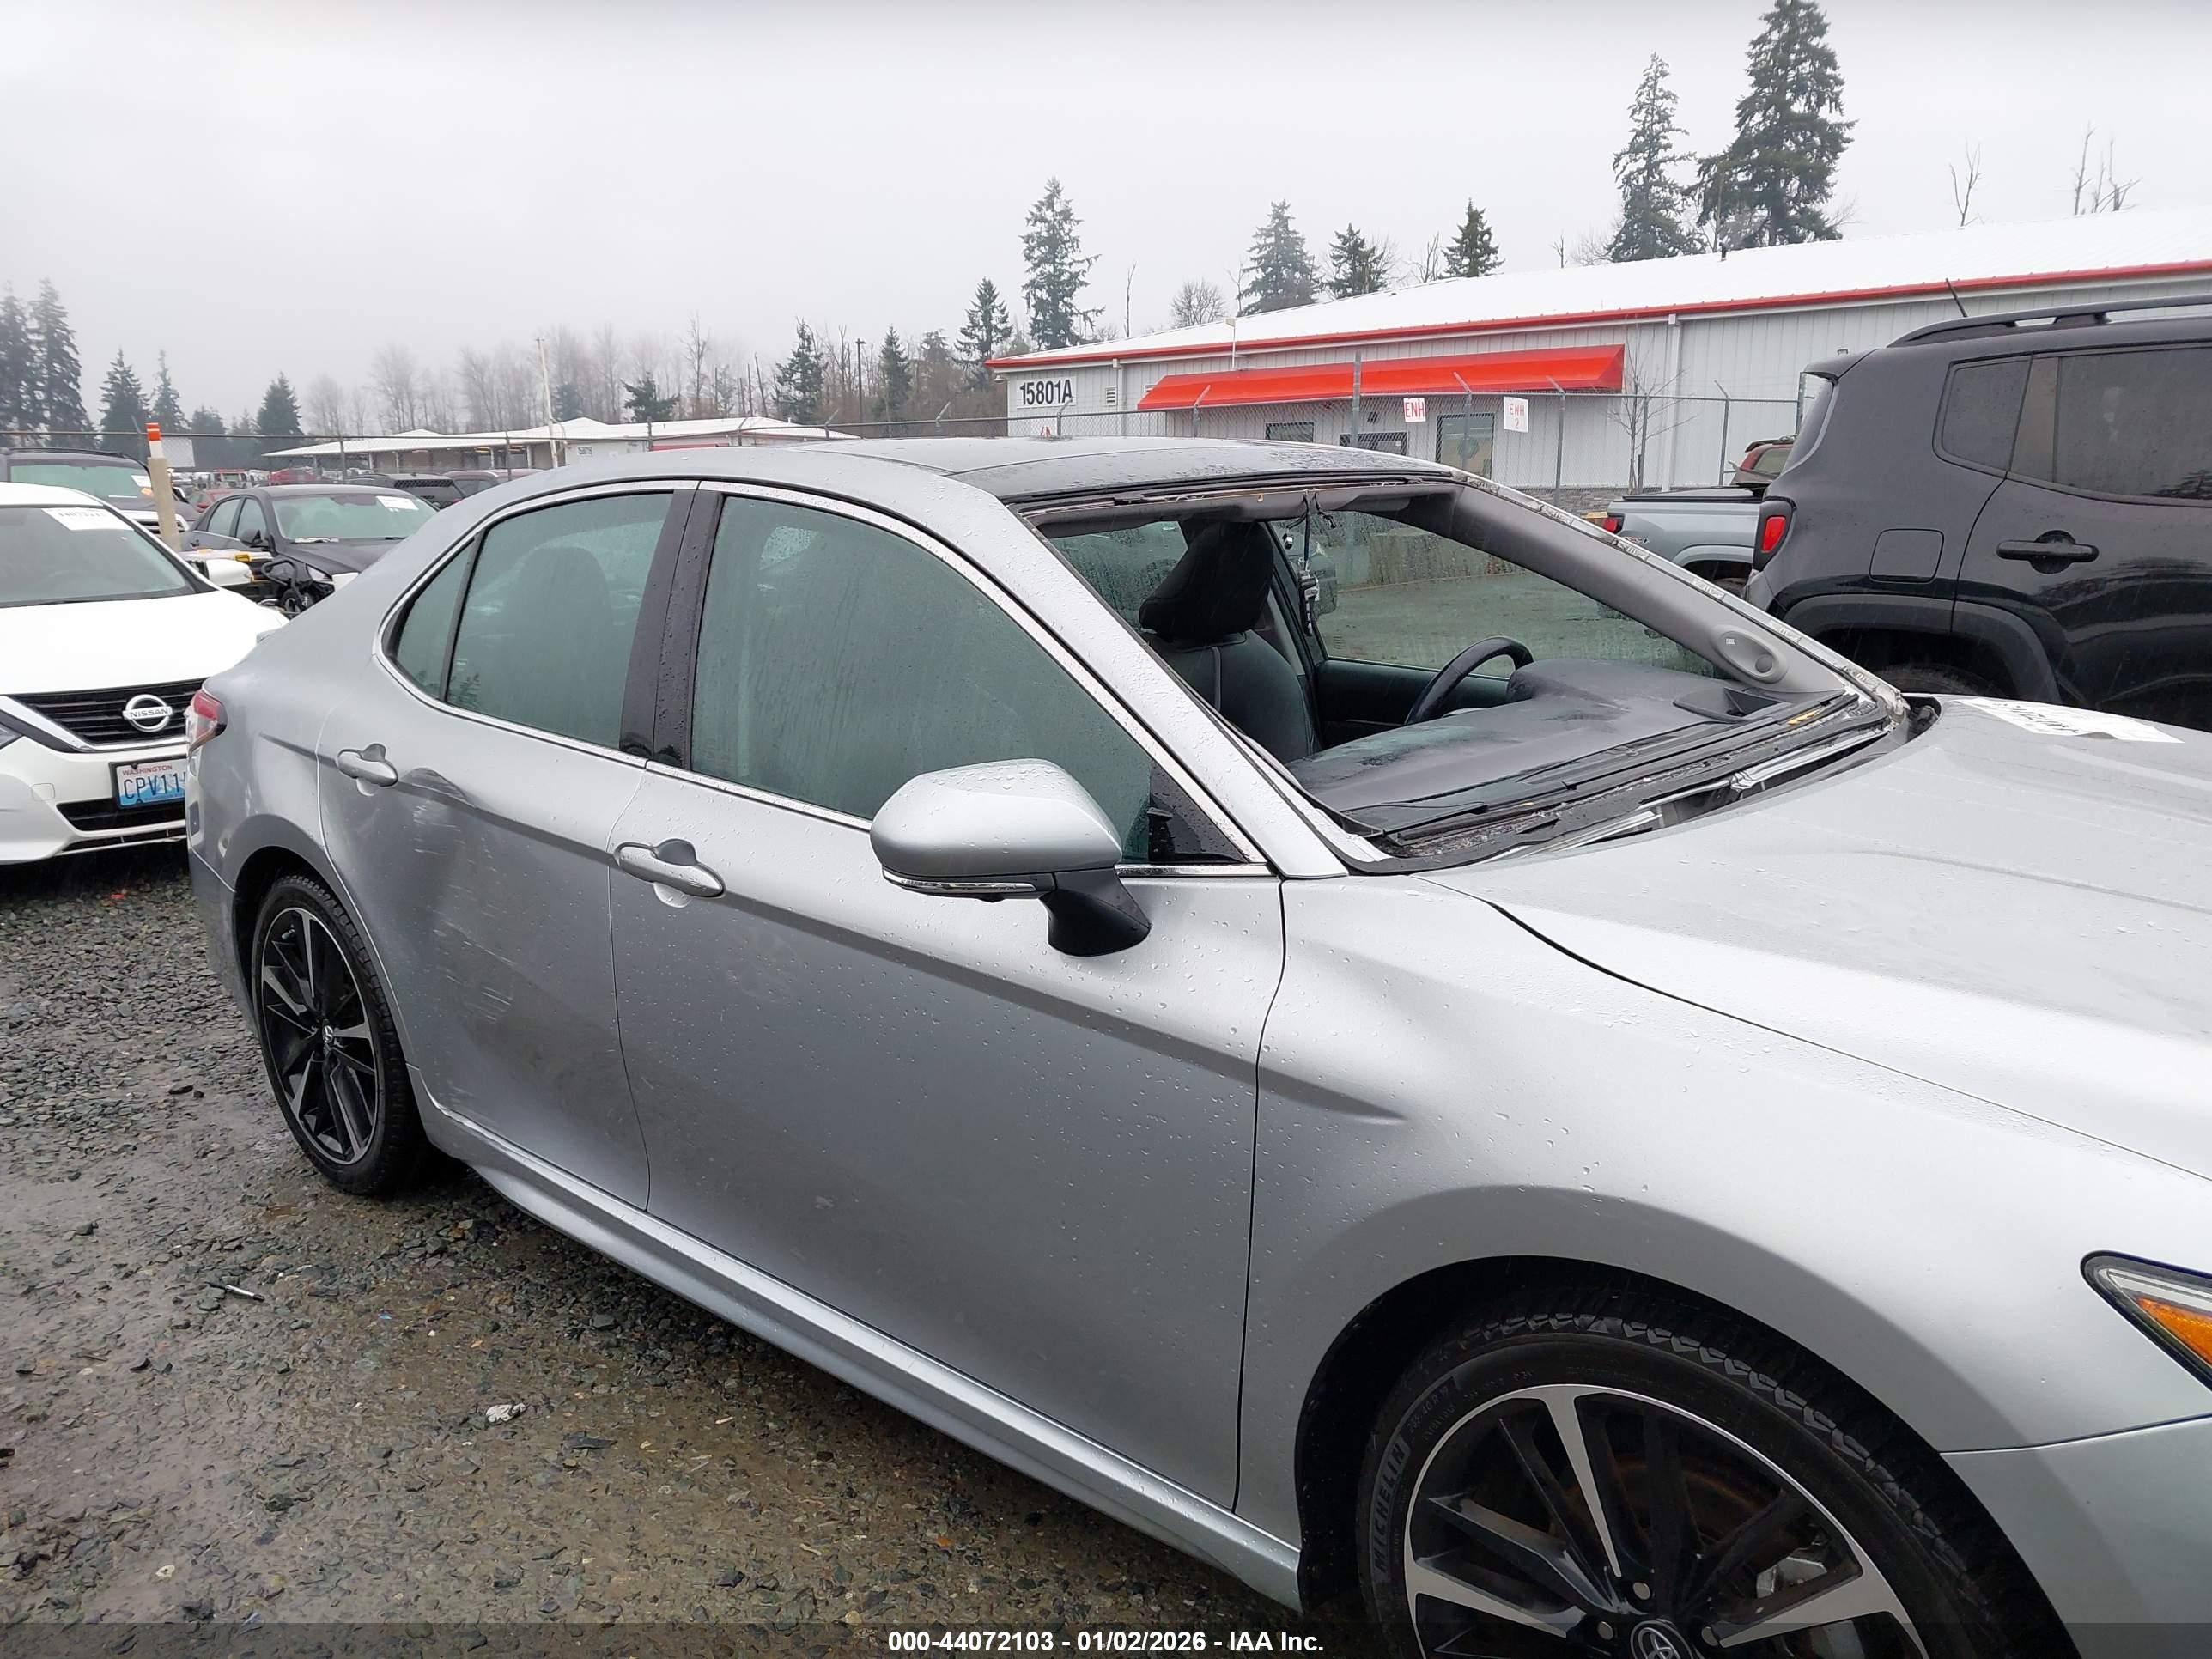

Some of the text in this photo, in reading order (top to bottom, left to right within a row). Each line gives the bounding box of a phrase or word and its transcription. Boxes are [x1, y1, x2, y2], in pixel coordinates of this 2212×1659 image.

[1019, 380, 1073, 405] 15801A
[1405, 402, 1425, 418] ENH
[1509, 404, 1525, 416] ENH
[130, 708, 168, 718] NISSAN
[122, 765, 173, 776] WASHINGTON
[124, 772, 185, 799] CPV11
[1373, 1442, 1407, 1575] MICHELIN
